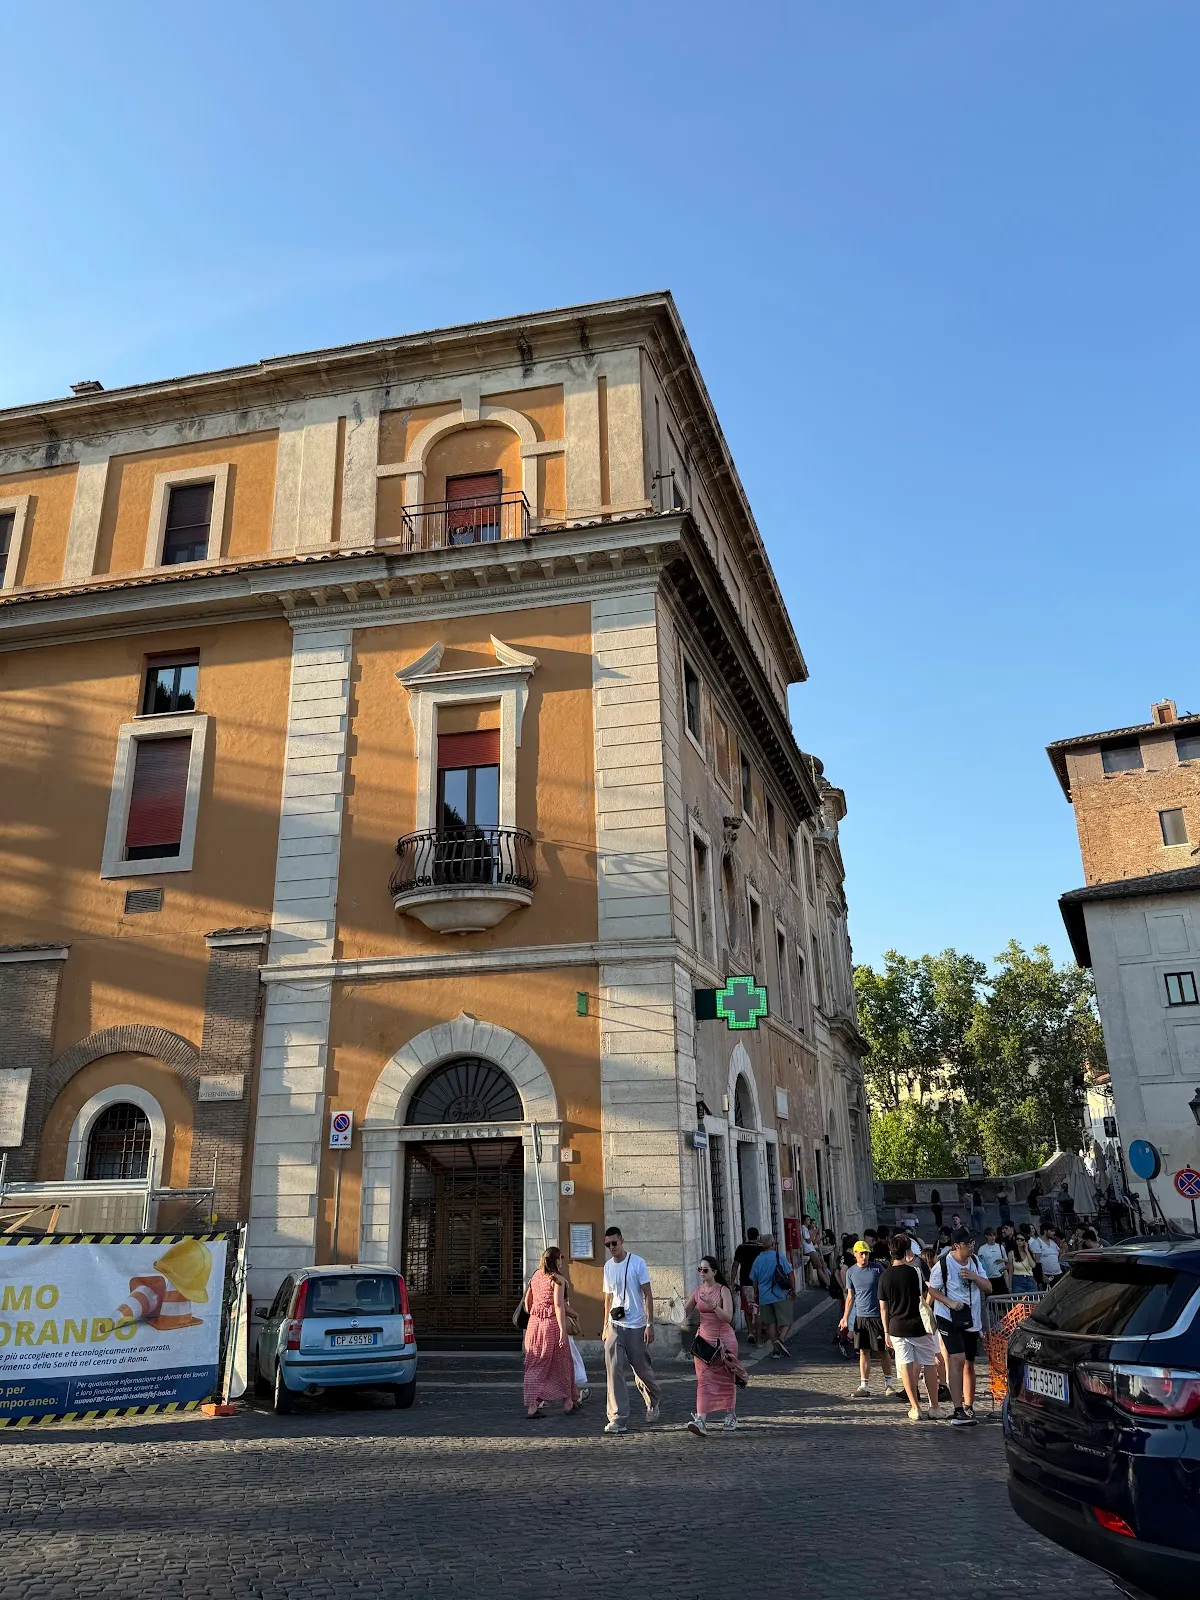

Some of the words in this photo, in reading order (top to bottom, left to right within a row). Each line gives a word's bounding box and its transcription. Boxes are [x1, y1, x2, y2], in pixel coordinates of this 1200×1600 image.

[422, 1128, 504, 1140] FARMACIA
[1, 1284, 59, 1311] MO
[336, 1336, 346, 1345] CP
[348, 1334, 373, 1344] 495YB
[4, 1352, 17, 1363] più
[19, 1351, 63, 1361] accogliente
[71, 1347, 138, 1357] tecnologicamente
[138, 1344, 171, 1353] avanzato,
[32, 1361, 52, 1369] della
[53, 1359, 78, 1368] Sanità
[79, 1358, 92, 1367] nel
[92, 1357, 117, 1366] centro
[118, 1356, 127, 1364] di
[127, 1355, 149, 1363] Roma.
[88, 1379, 120, 1389] qualunque
[119, 1376, 157, 1386] informazione
[182, 1371, 192, 1379] dei
[6, 1386, 26, 1397] per
[93, 1387, 114, 1397] finalità
[114, 1386, 133, 1394] potete
[133, 1384, 154, 1392] scrivere
